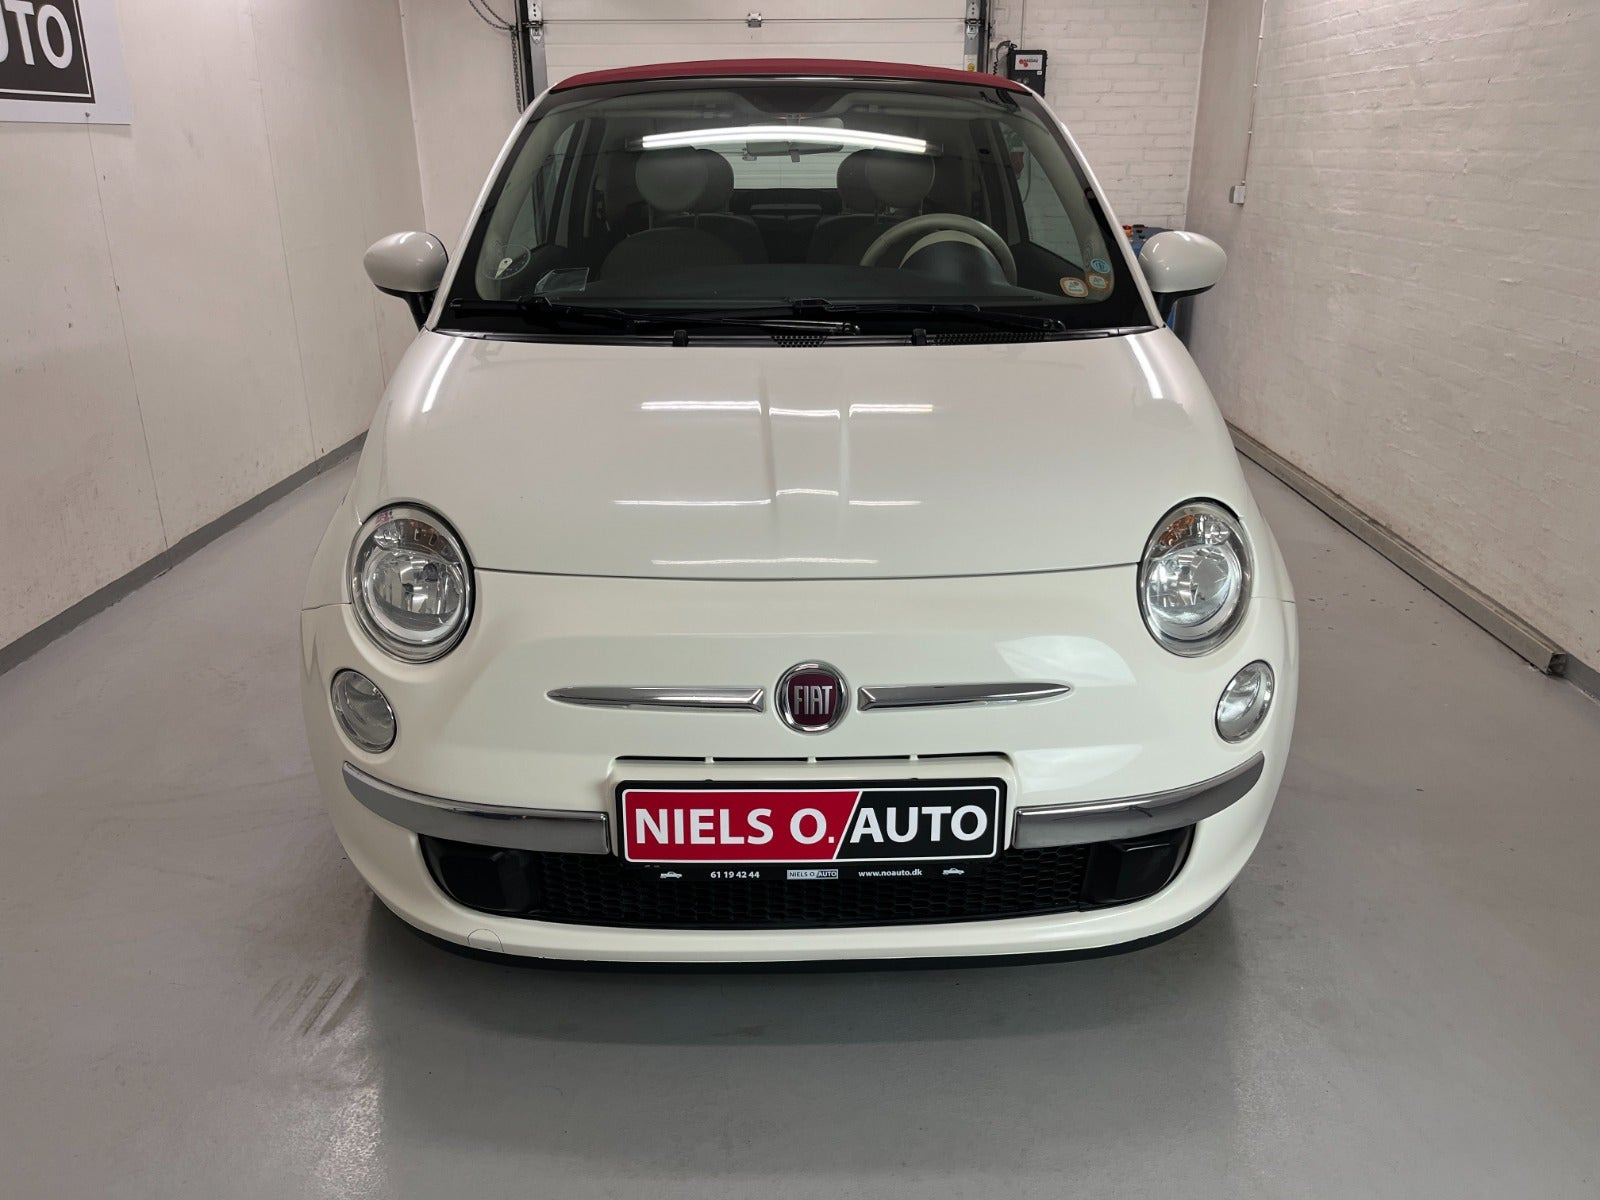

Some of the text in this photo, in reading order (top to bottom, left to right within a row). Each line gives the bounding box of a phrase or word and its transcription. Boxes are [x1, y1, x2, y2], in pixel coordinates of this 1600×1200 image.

[0, 0, 73, 69] TO
[793, 685, 833, 715] FIAT
[635, 805, 988, 845] NIELS O. AUTO
[710, 871, 760, 879] 61 19 42 44
[858, 869, 923, 878] www.noauto.dk
